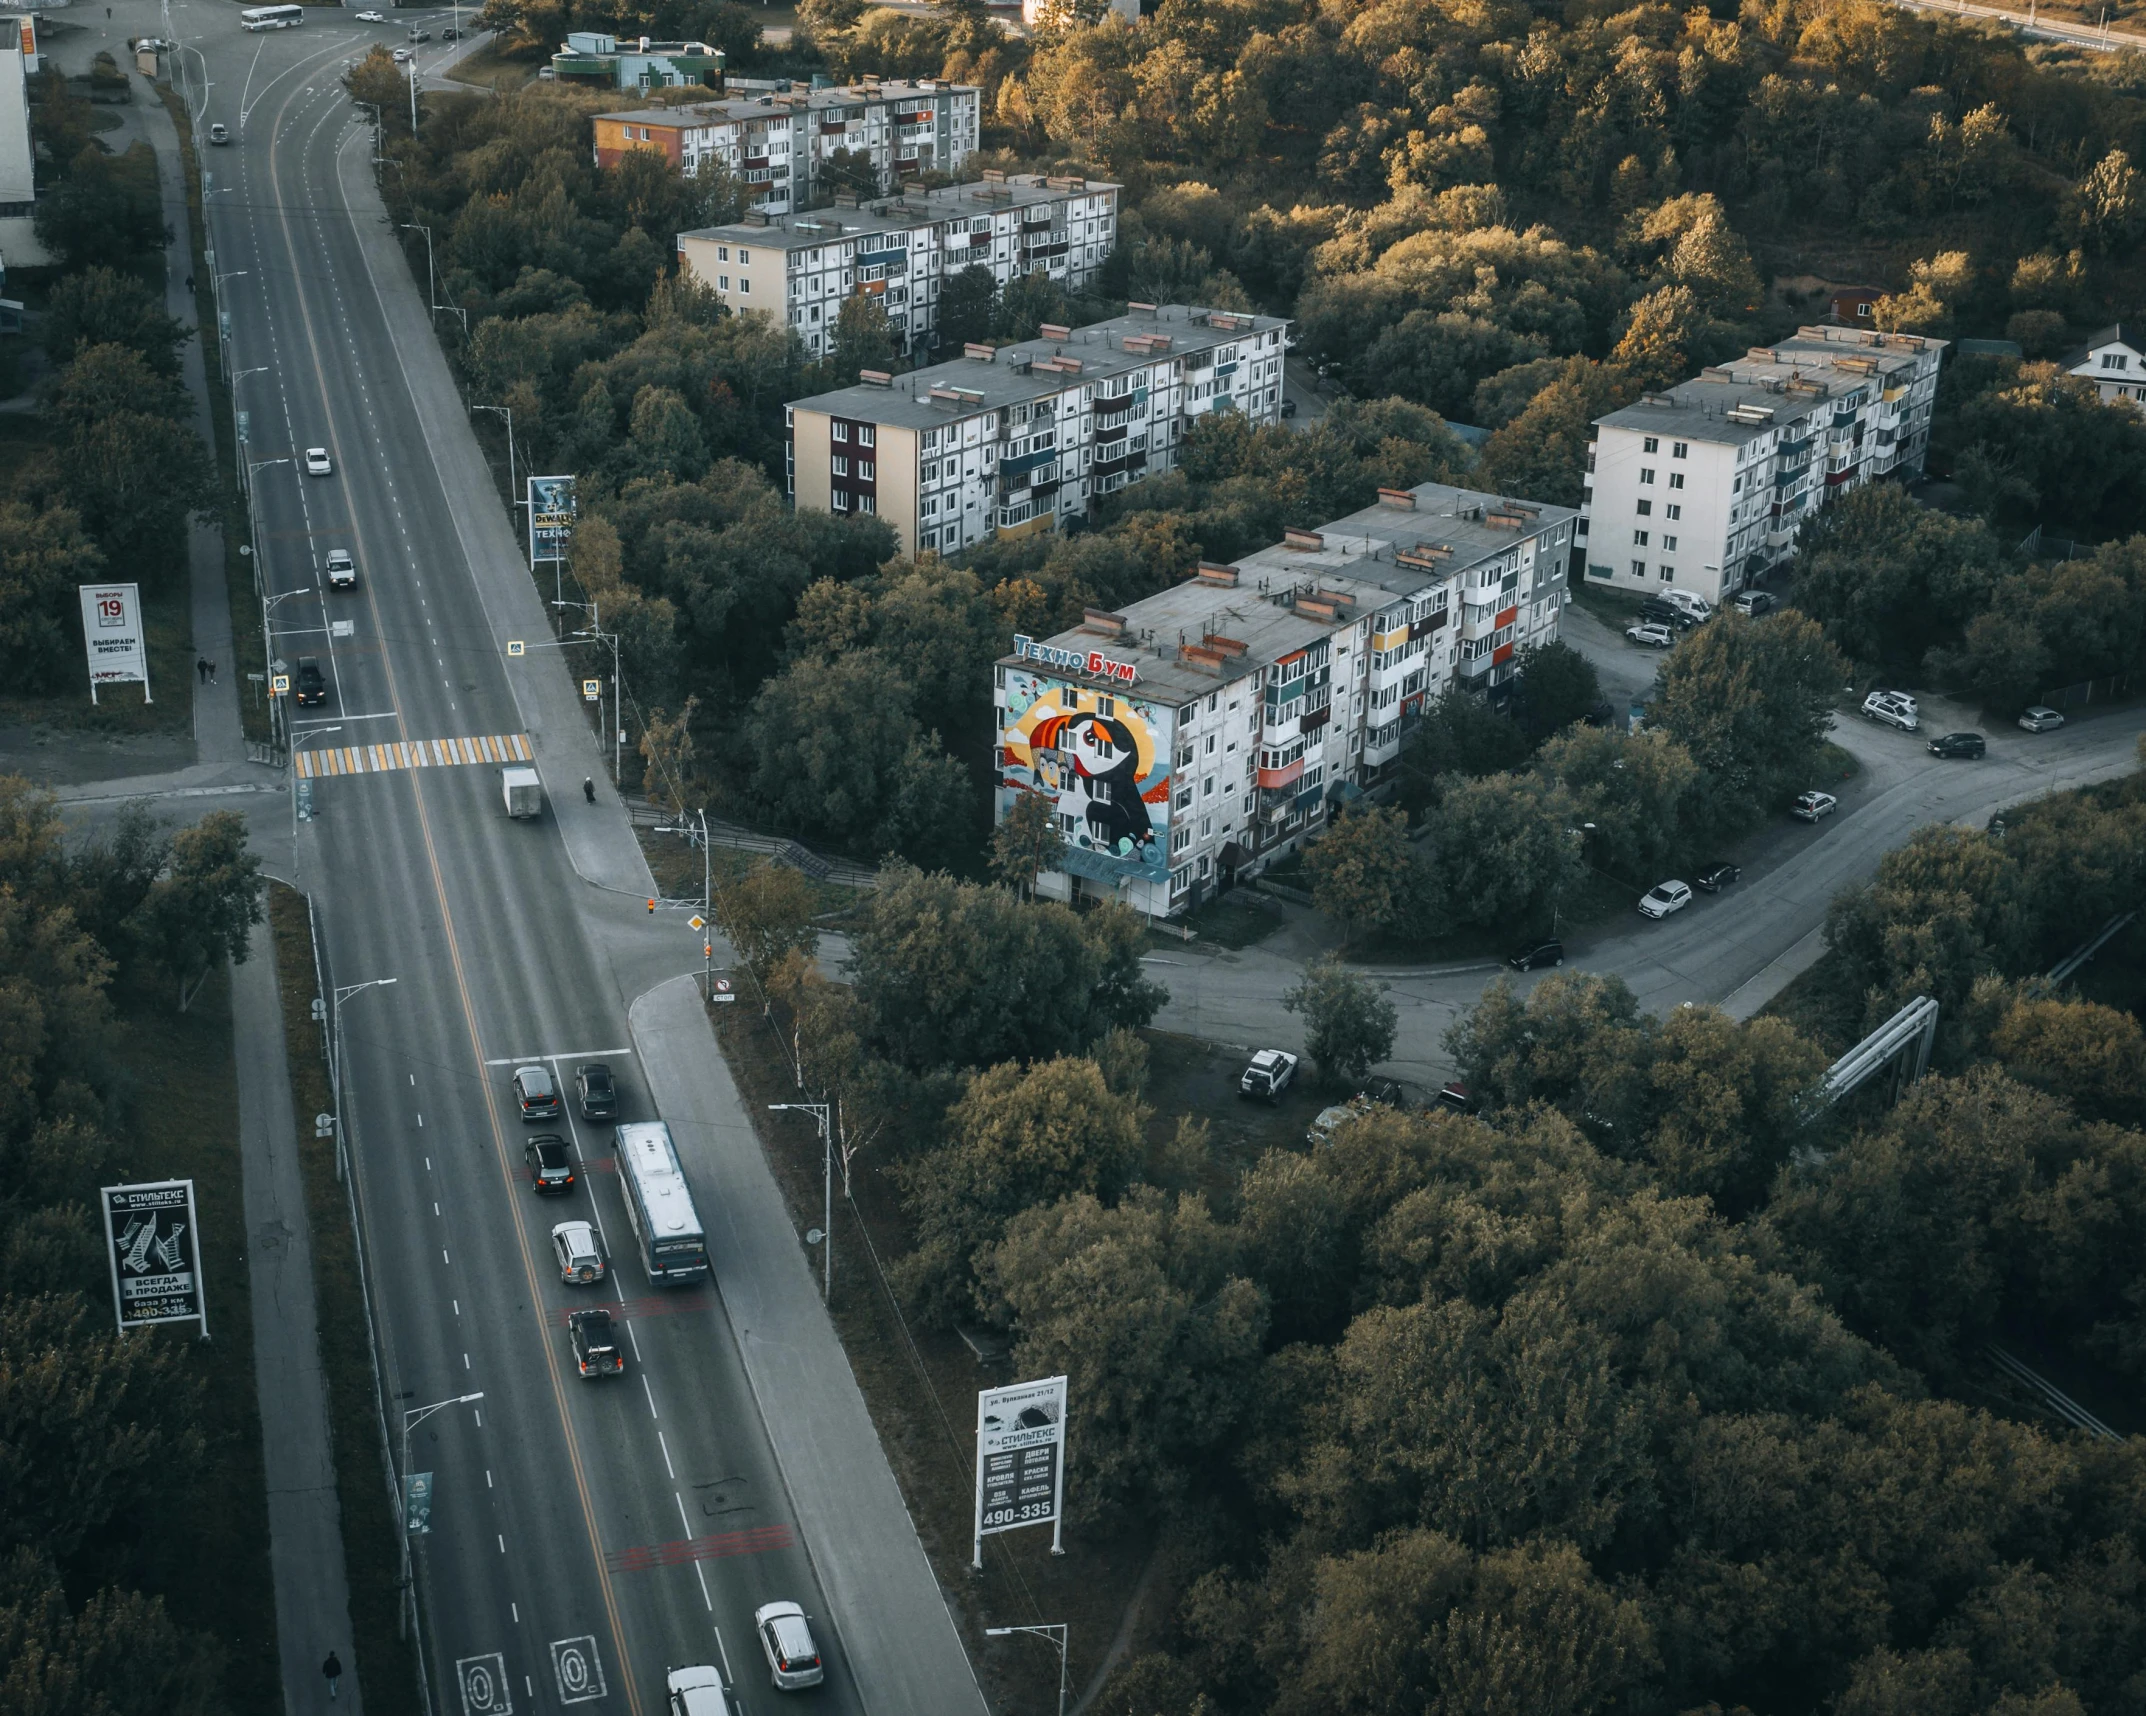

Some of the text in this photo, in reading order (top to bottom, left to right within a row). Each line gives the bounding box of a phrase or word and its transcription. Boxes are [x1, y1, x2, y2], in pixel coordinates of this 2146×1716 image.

[99, 600, 122, 617] 19
[93, 638, 136, 646] ВЫБИРАЕМ
[128, 1190, 184, 1203] СТИЛЬТЕКС
[135, 1276, 178, 1287] ВСЕГДА
[125, 1283, 190, 1297] В ПРОДАЖЕ
[134, 1300, 158, 1308] база
[161, 1297, 168, 1305] 9
[1036, 1388, 1054, 1397] 21/12
[1001, 1427, 1055, 1445] СТИЛЬТЕКС
[1025, 1448, 1050, 1459] ДВЕРИ
[1024, 1466, 1049, 1476] КРАСКИ
[987, 1472, 1014, 1483] КРОВЛЯ
[1021, 1484, 1050, 1495] КАФЕЛЬ
[983, 1501, 1051, 1525] 490-335
